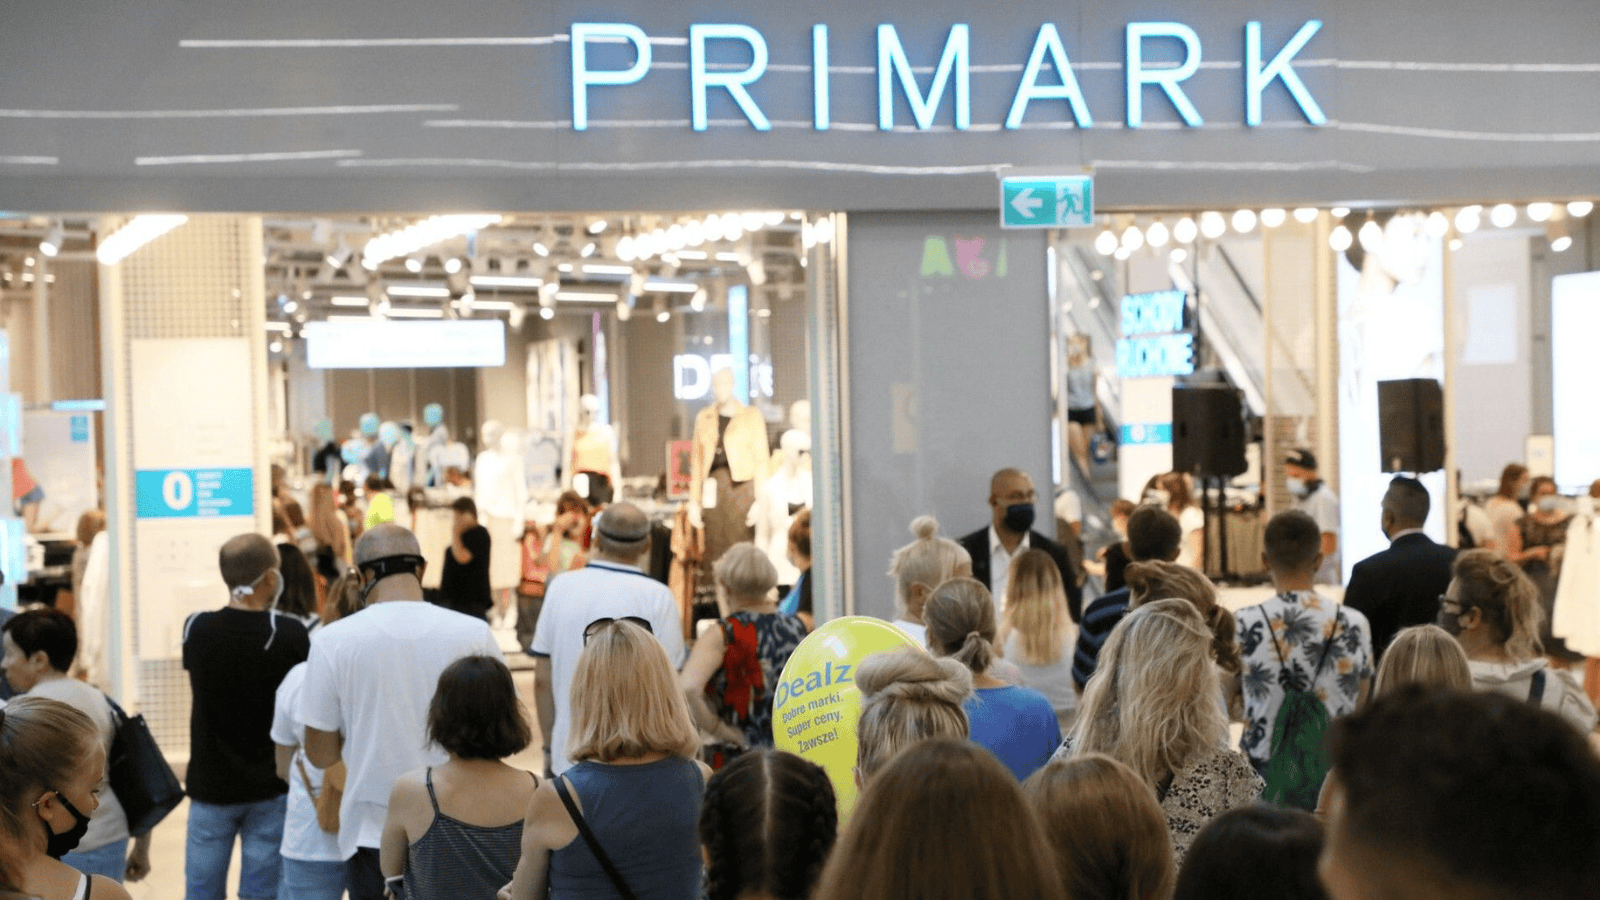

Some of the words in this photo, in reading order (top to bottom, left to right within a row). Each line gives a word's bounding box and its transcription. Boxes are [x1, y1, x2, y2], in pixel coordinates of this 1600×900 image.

[571, 20, 1327, 131] PRIMARK
[163, 471, 192, 510] 0
[776, 661, 853, 710] Dealz
[782, 704, 806, 723] Dobre
[808, 692, 844, 710] marki.
[787, 719, 811, 738] Super
[814, 711, 843, 726] ceny.
[798, 728, 839, 754] Zawsze!
